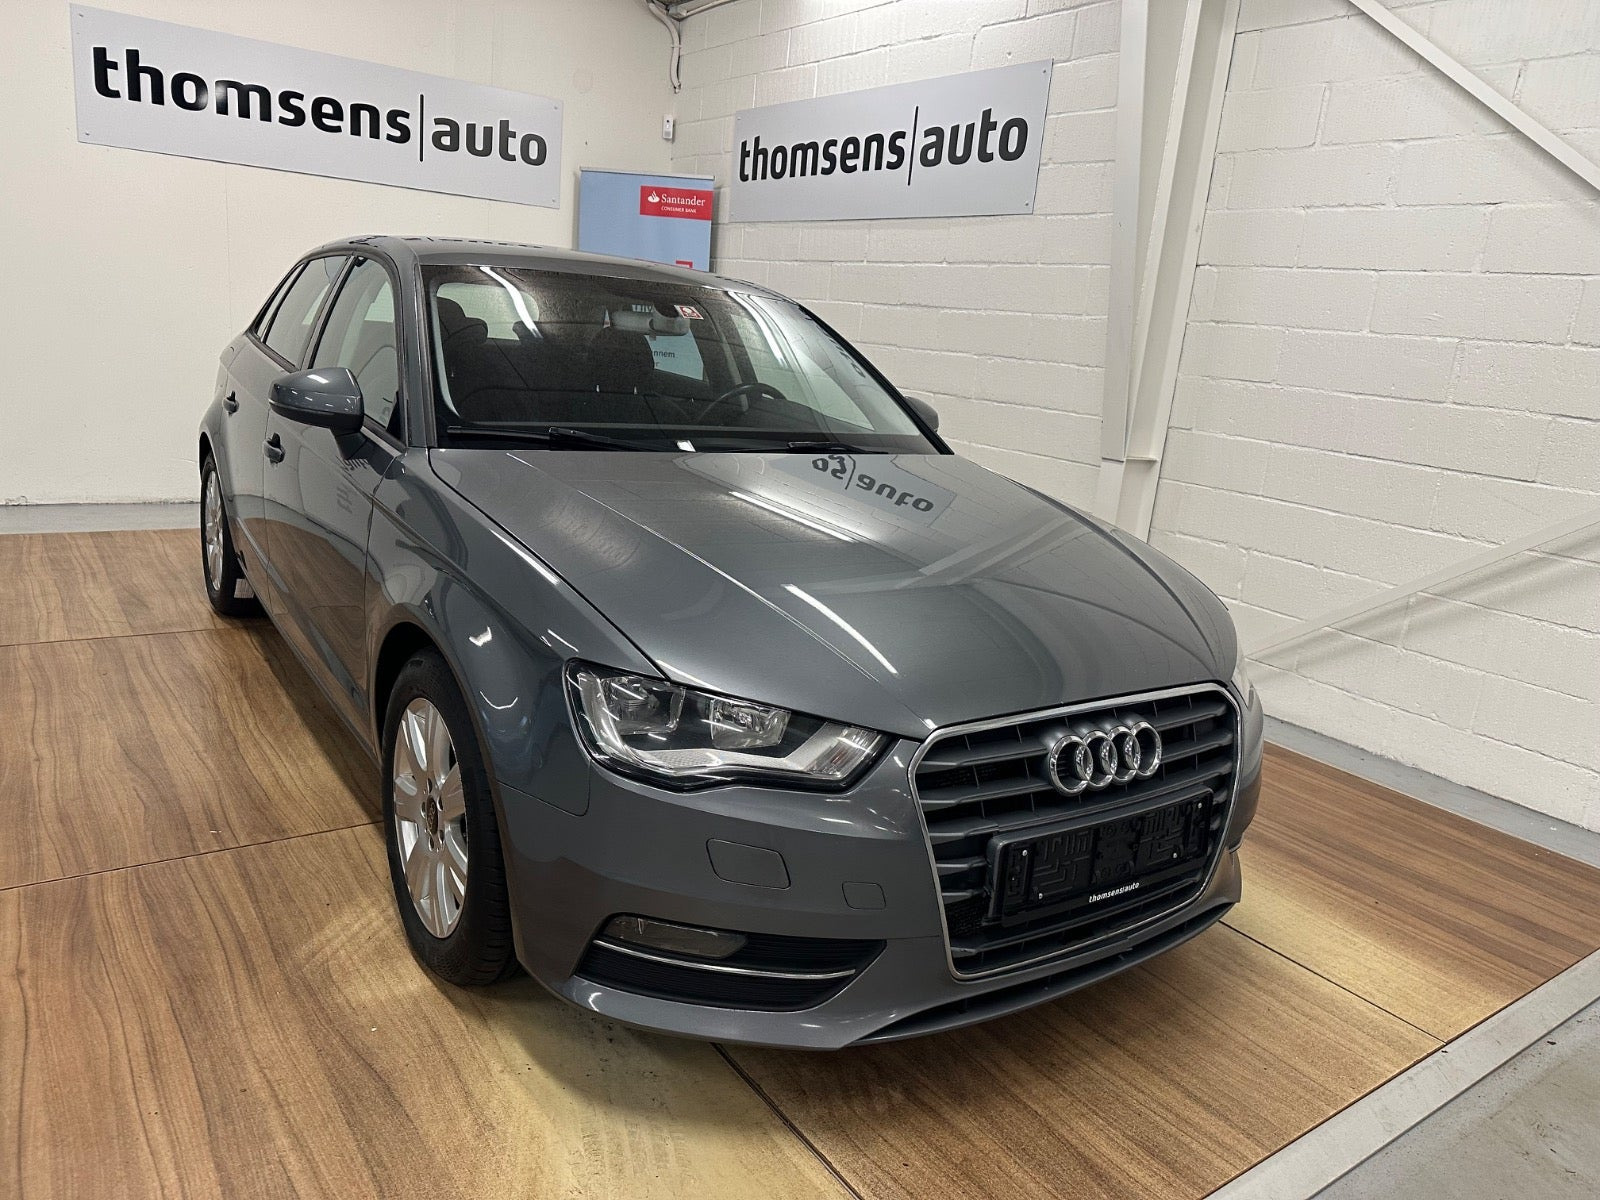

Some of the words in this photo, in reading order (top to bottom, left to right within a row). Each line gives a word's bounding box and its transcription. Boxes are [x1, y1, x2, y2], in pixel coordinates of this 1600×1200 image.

[92, 46, 411, 144] thomsens
[431, 117, 548, 168] auto
[739, 131, 907, 183] thomsens
[919, 109, 1029, 168] auto
[662, 194, 706, 206] Santander
